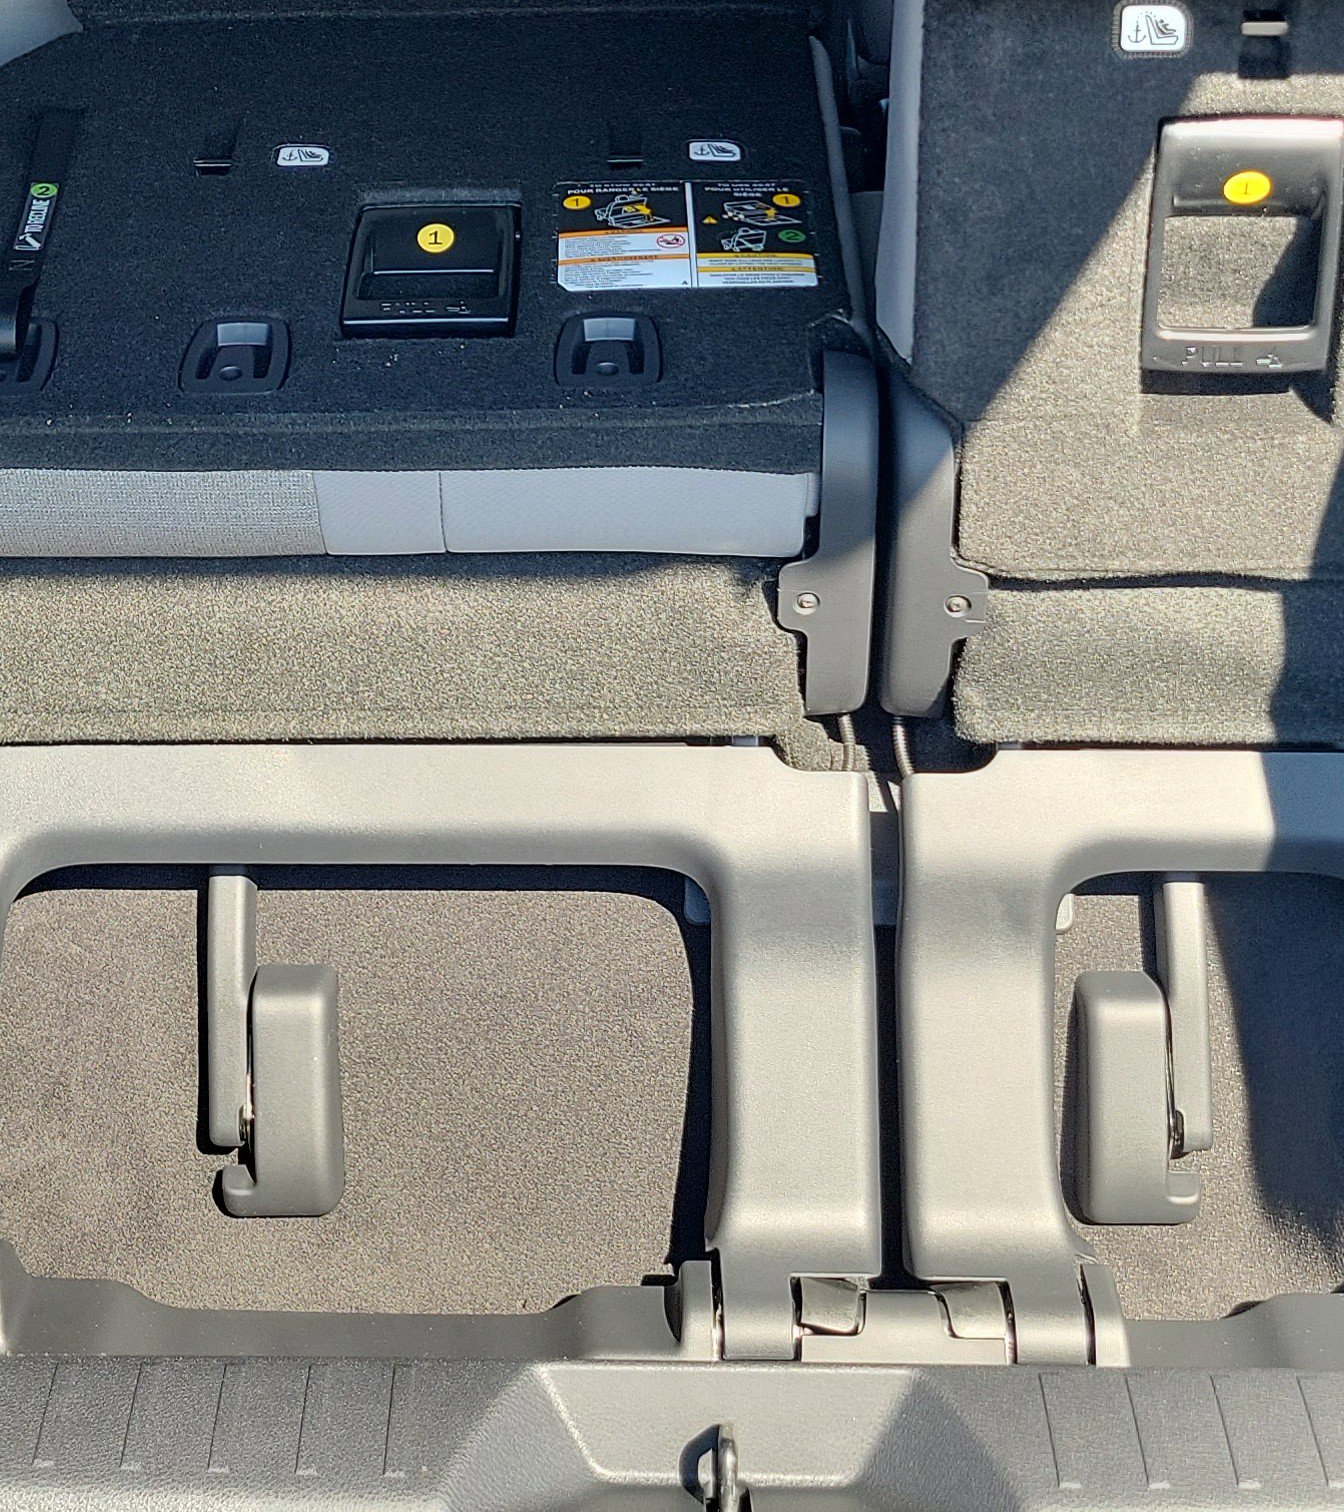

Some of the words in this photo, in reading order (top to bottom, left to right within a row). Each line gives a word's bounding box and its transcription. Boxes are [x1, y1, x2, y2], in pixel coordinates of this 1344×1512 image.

[37, 186, 51, 196] 2
[428, 230, 443, 245] 1
[785, 232, 798, 240] 2
[1181, 346, 1243, 368] PULL
